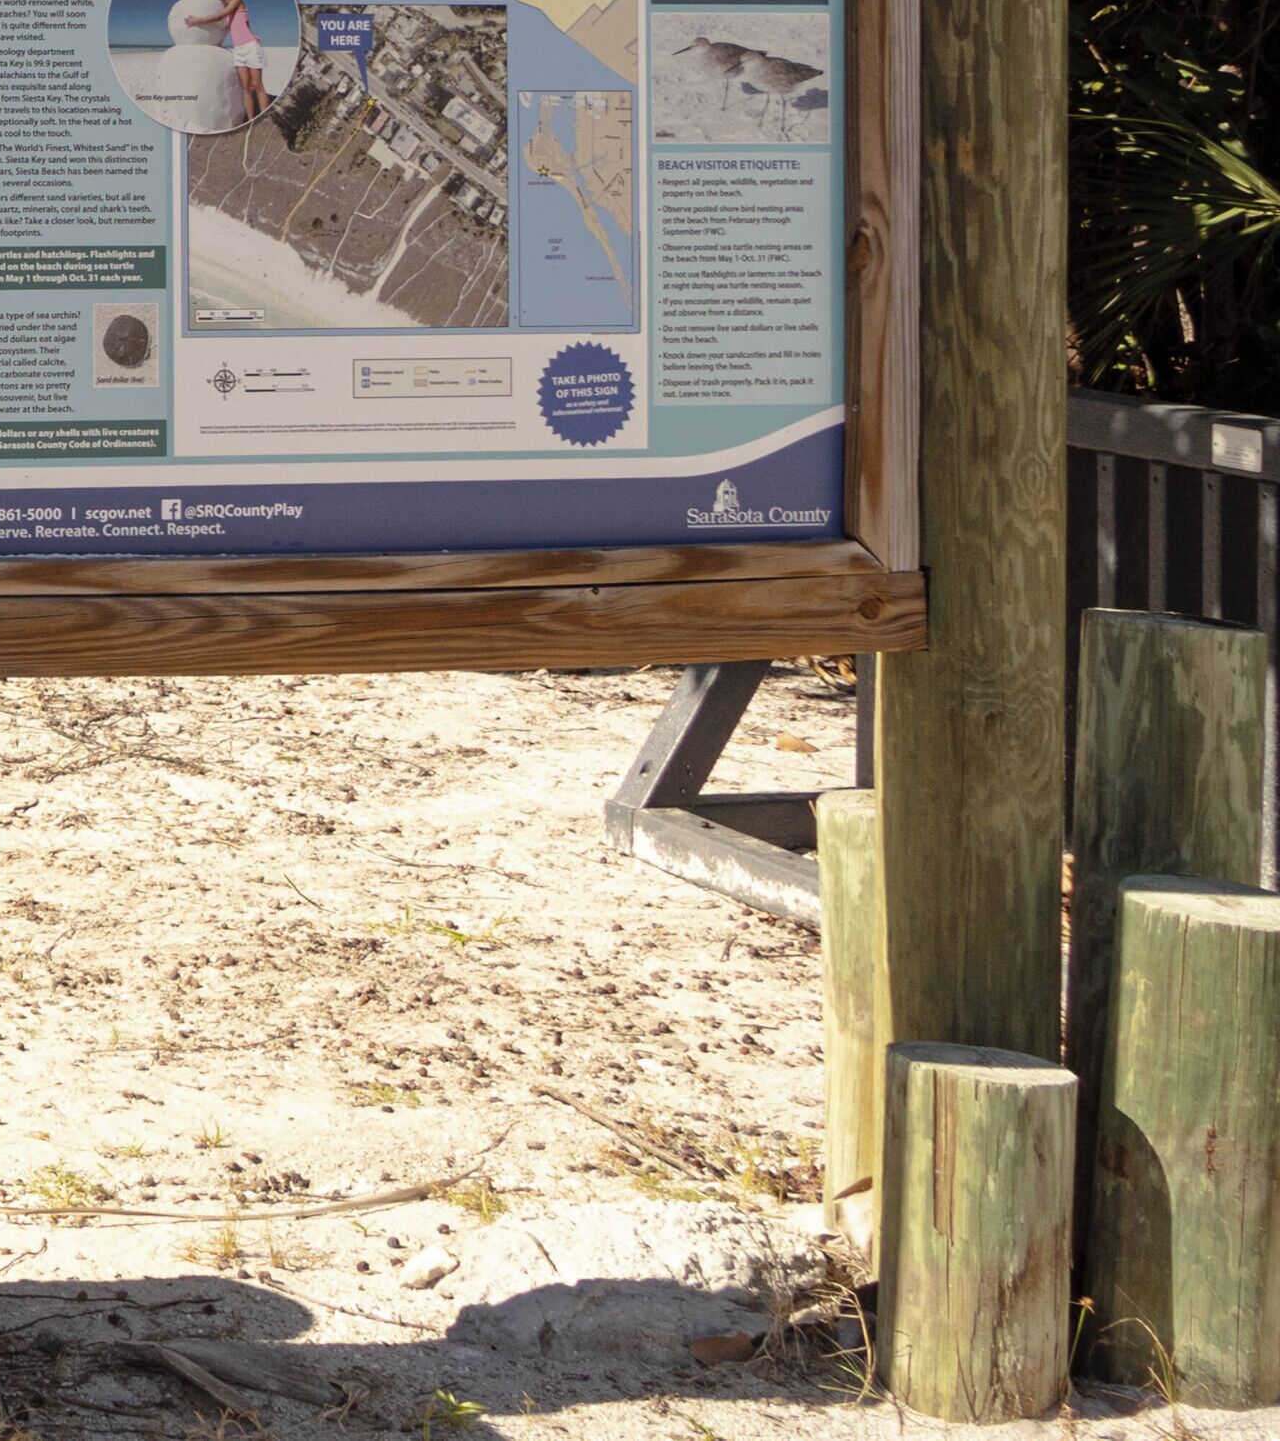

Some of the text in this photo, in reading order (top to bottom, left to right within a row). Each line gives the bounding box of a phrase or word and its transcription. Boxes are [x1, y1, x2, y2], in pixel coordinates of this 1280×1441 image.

[321, 20, 369, 31] YOU ARE
[330, 35, 360, 46] HERE
[658, 160, 800, 171] BEACH VISITOR ETIQUETTE:
[23, 250, 40, 260] and
[41, 250, 88, 262] hatchlings.
[89, 250, 136, 261] Flashlights
[138, 249, 155, 259] and
[20, 262, 34, 271] the
[35, 262, 62, 271] beach
[63, 262, 92, 273] during
[109, 261, 134, 271] turtle
[5, 274, 24, 286] May
[26, 274, 30, 283] 1
[32, 274, 67, 285] through
[68, 274, 86, 283] Oct.
[88, 274, 98, 283] 31
[100, 273, 120, 283] each
[121, 275, 142, 285] year.
[552, 373, 620, 386] TAKE A PHOTO
[555, 386, 618, 398] OF THIS SIGN
[38, 431, 54, 440] any
[55, 428, 80, 438] shells
[81, 428, 101, 438] with
[101, 428, 118, 437] live
[119, 427, 159, 437] creatures
[36, 440, 67, 452] County
[68, 440, 90, 450] Code
[91, 440, 101, 449] of
[102, 439, 155, 449] Ordinances).
[85, 505, 151, 525] scgov.net
[184, 502, 302, 523] @SRQCountyPlay
[687, 507, 832, 527] Sarasota County
[35, 524, 99, 539] Recreate.
[102, 523, 163, 538] Connect.
[167, 522, 225, 540] Respect.
